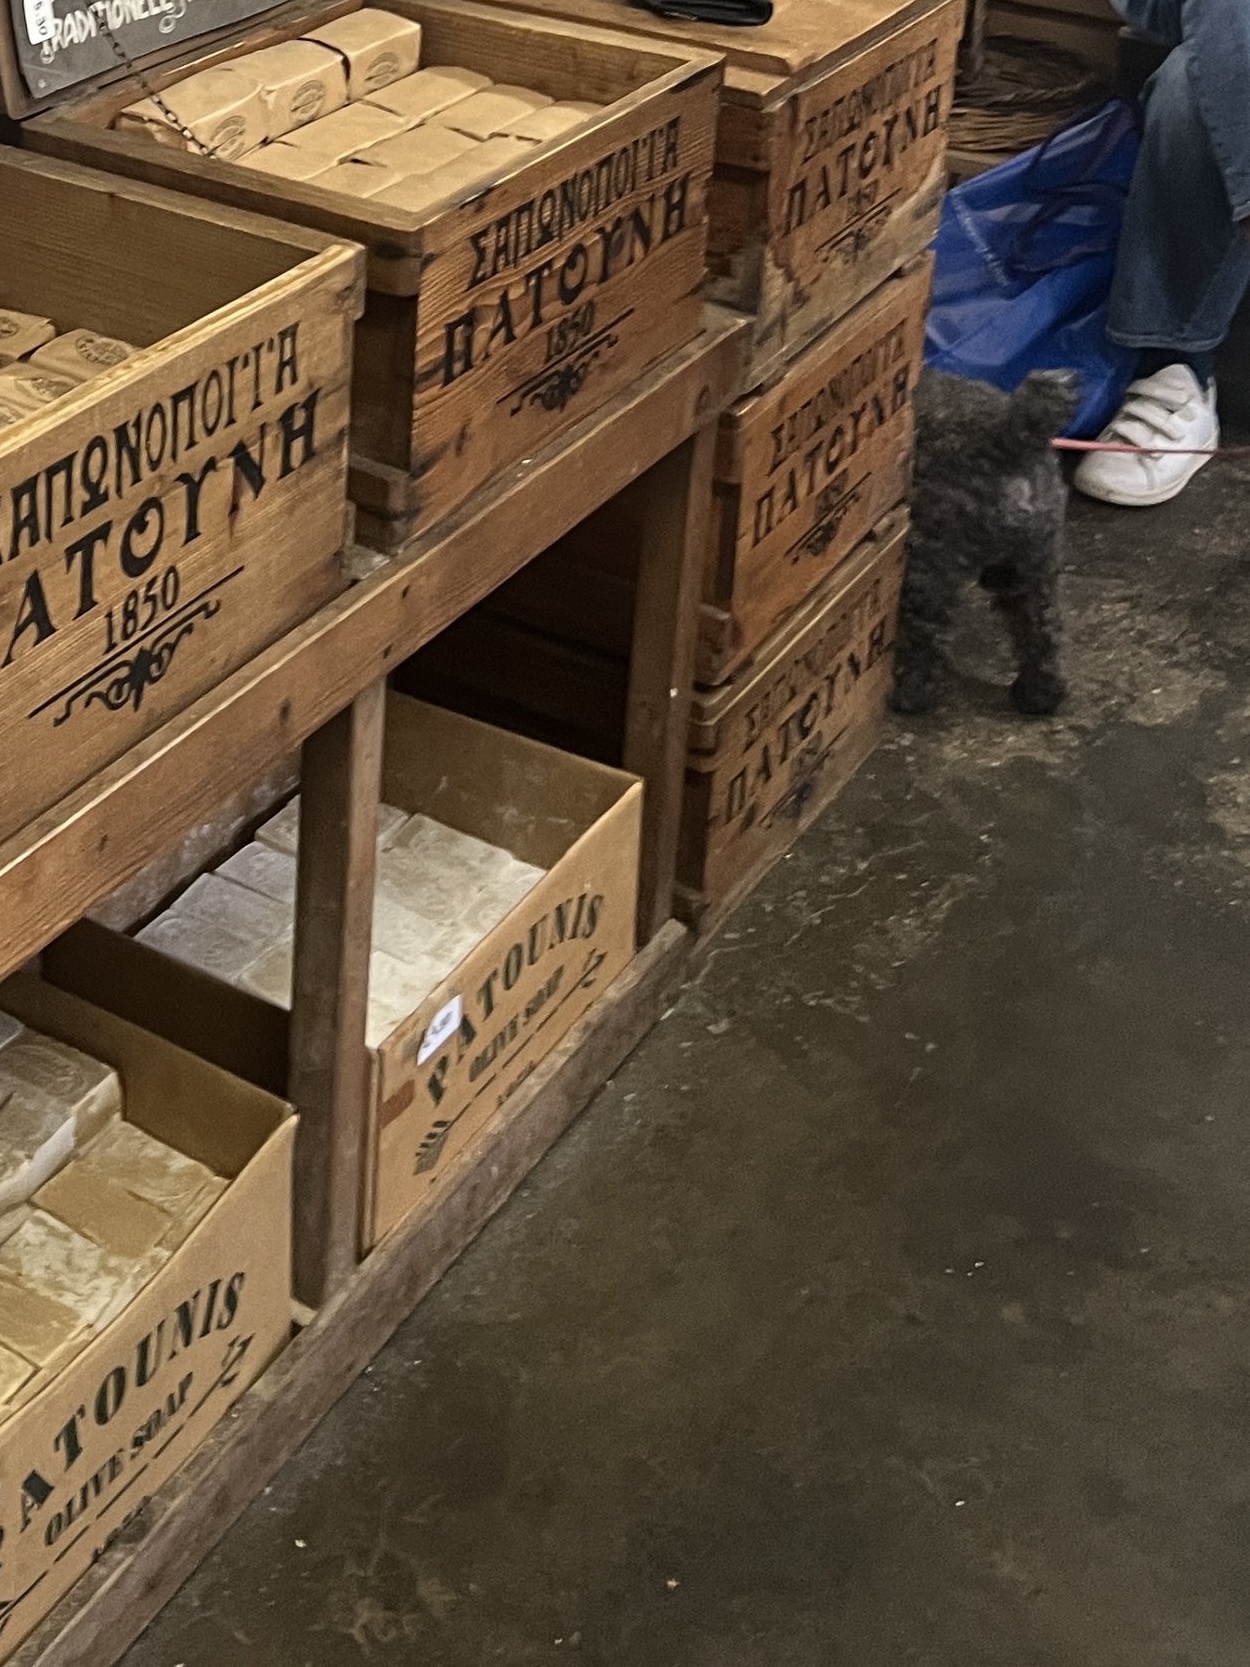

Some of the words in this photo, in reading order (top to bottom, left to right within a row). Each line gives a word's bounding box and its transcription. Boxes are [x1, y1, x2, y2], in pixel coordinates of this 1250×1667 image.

[441, 172, 692, 388] ΠΑΤΟΥΝΗ
[103, 564, 181, 655] 1850
[44, 1448, 126, 1548] OLIVE
[129, 1371, 194, 1462] SOAP
